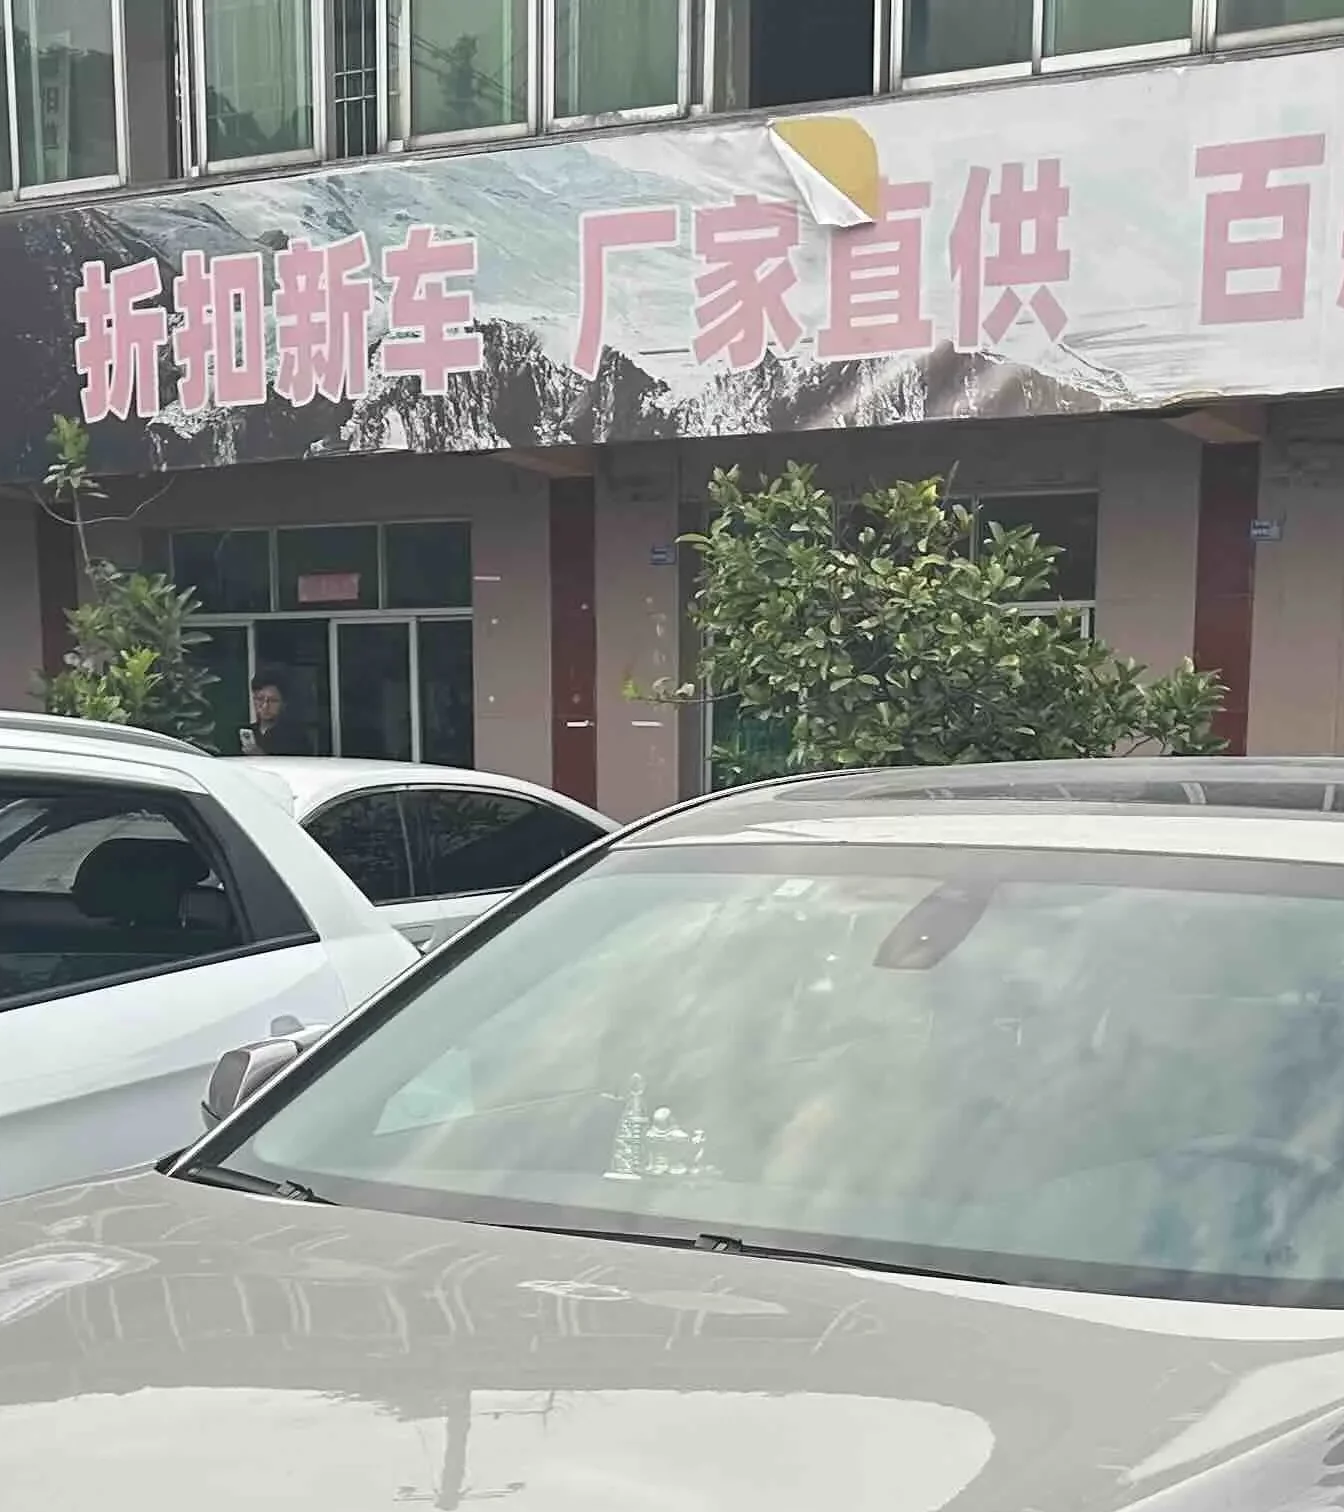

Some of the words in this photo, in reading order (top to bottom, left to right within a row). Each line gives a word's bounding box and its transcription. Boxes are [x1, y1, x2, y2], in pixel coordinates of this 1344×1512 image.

[74, 223, 484, 425] 折扣新车
[572, 157, 1072, 381] 厂家直供
